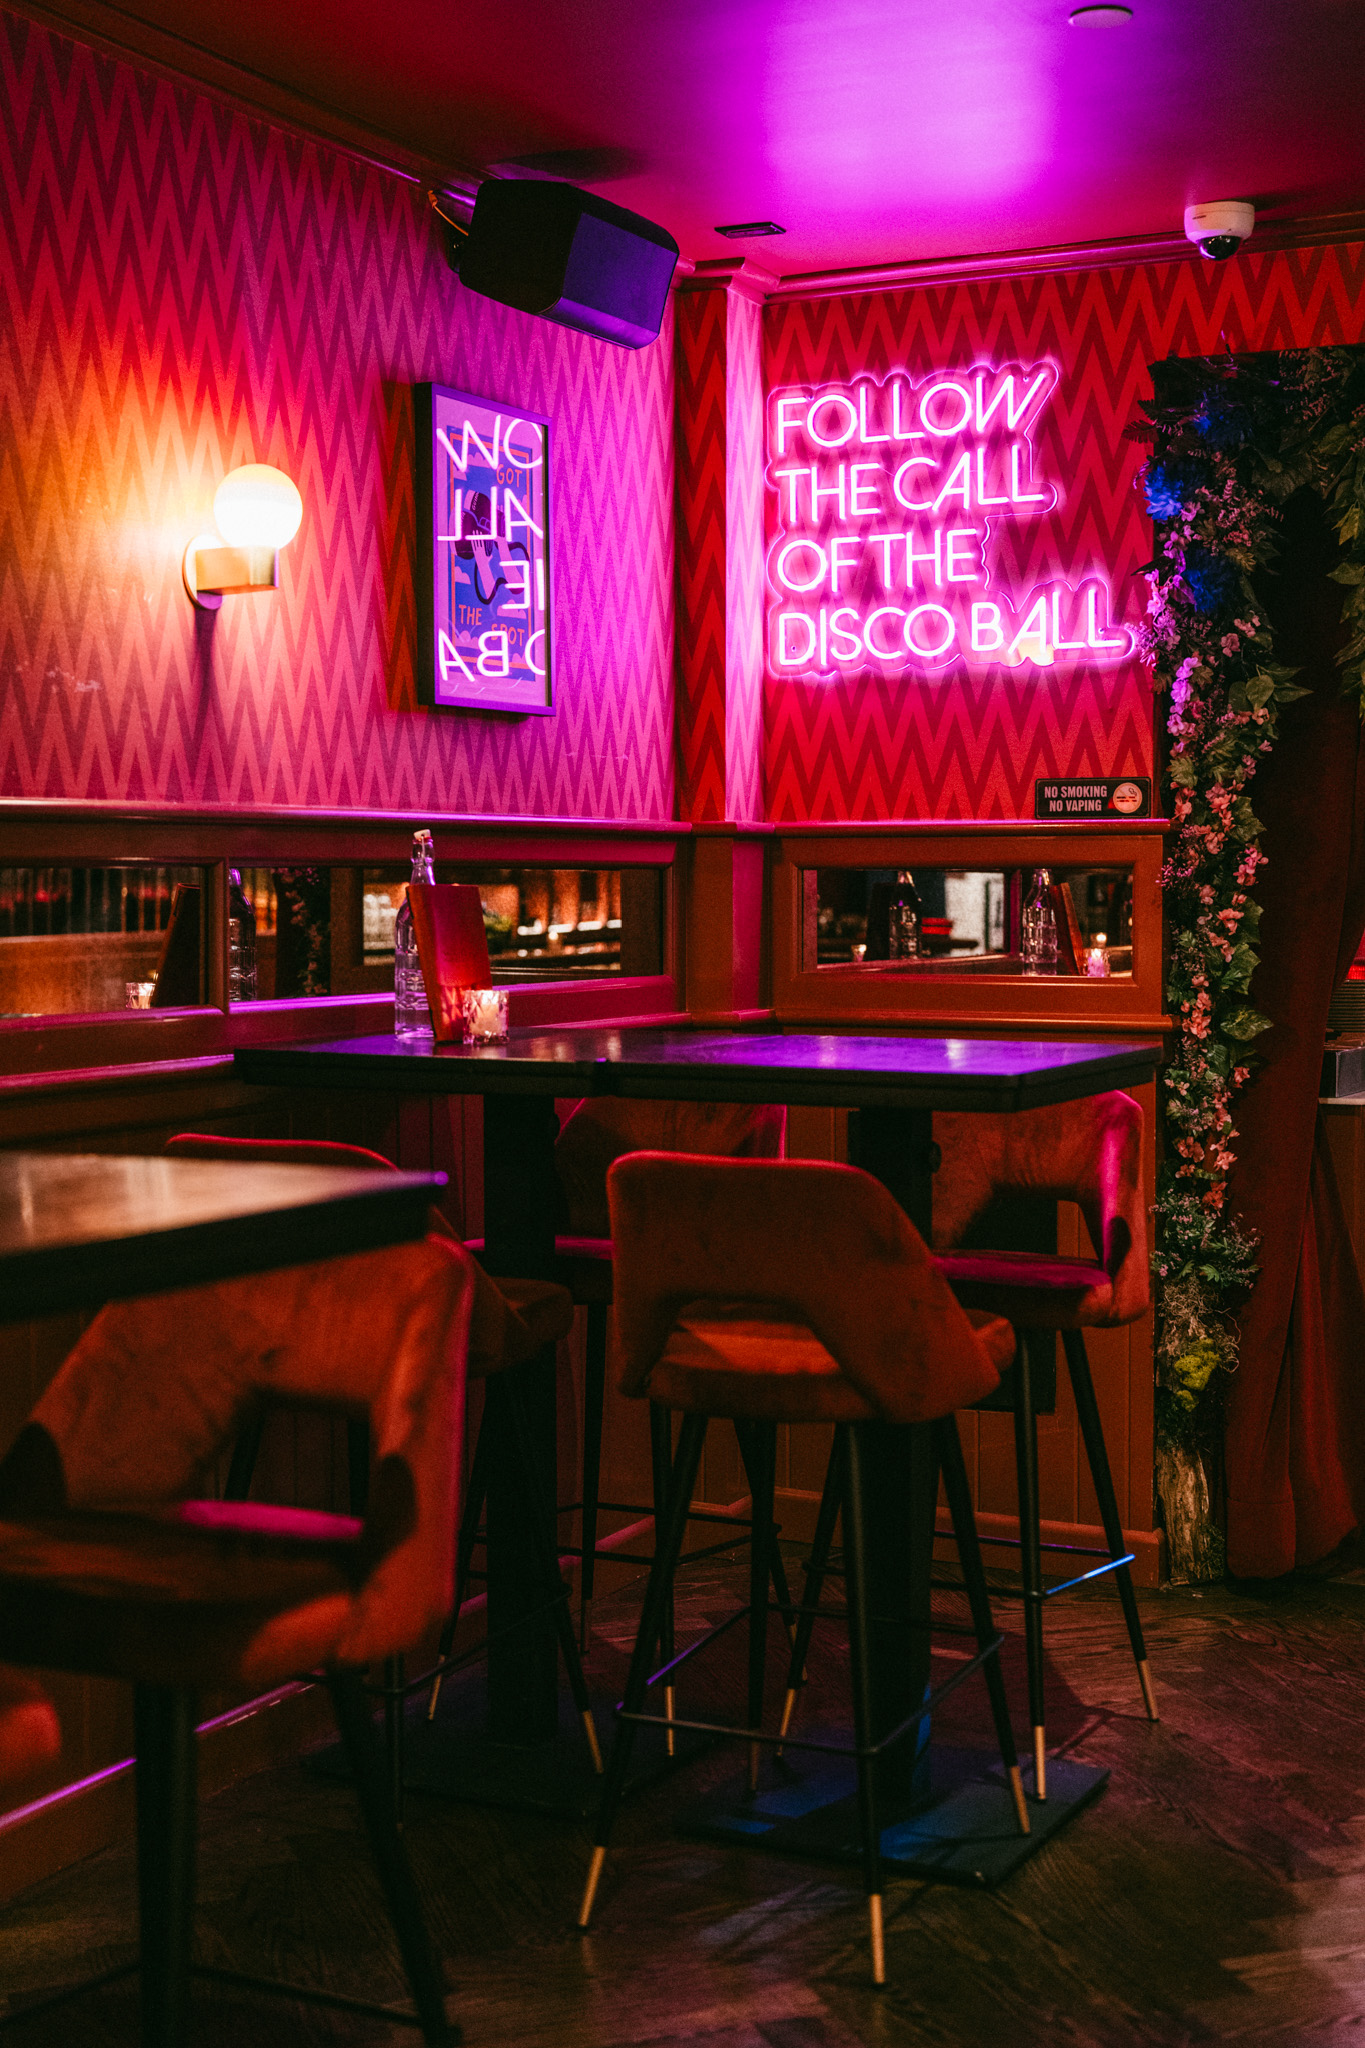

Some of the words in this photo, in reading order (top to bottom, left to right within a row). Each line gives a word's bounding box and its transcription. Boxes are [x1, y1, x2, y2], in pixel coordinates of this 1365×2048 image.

[776, 372, 1045, 455] FOLLOW
[496, 463, 523, 488] GOT
[775, 462, 880, 523] THE
[893, 444, 1045, 512] CALL
[776, 536, 861, 593] OF
[869, 527, 978, 588] THE
[458, 604, 483, 626] THE
[778, 602, 956, 666] DISCO
[969, 587, 1123, 655] BALL
[1044, 785, 1058, 798] NO
[1061, 785, 1108, 798] SMOKING
[1049, 799, 1064, 812] NO
[1066, 799, 1102, 812] VAPING
